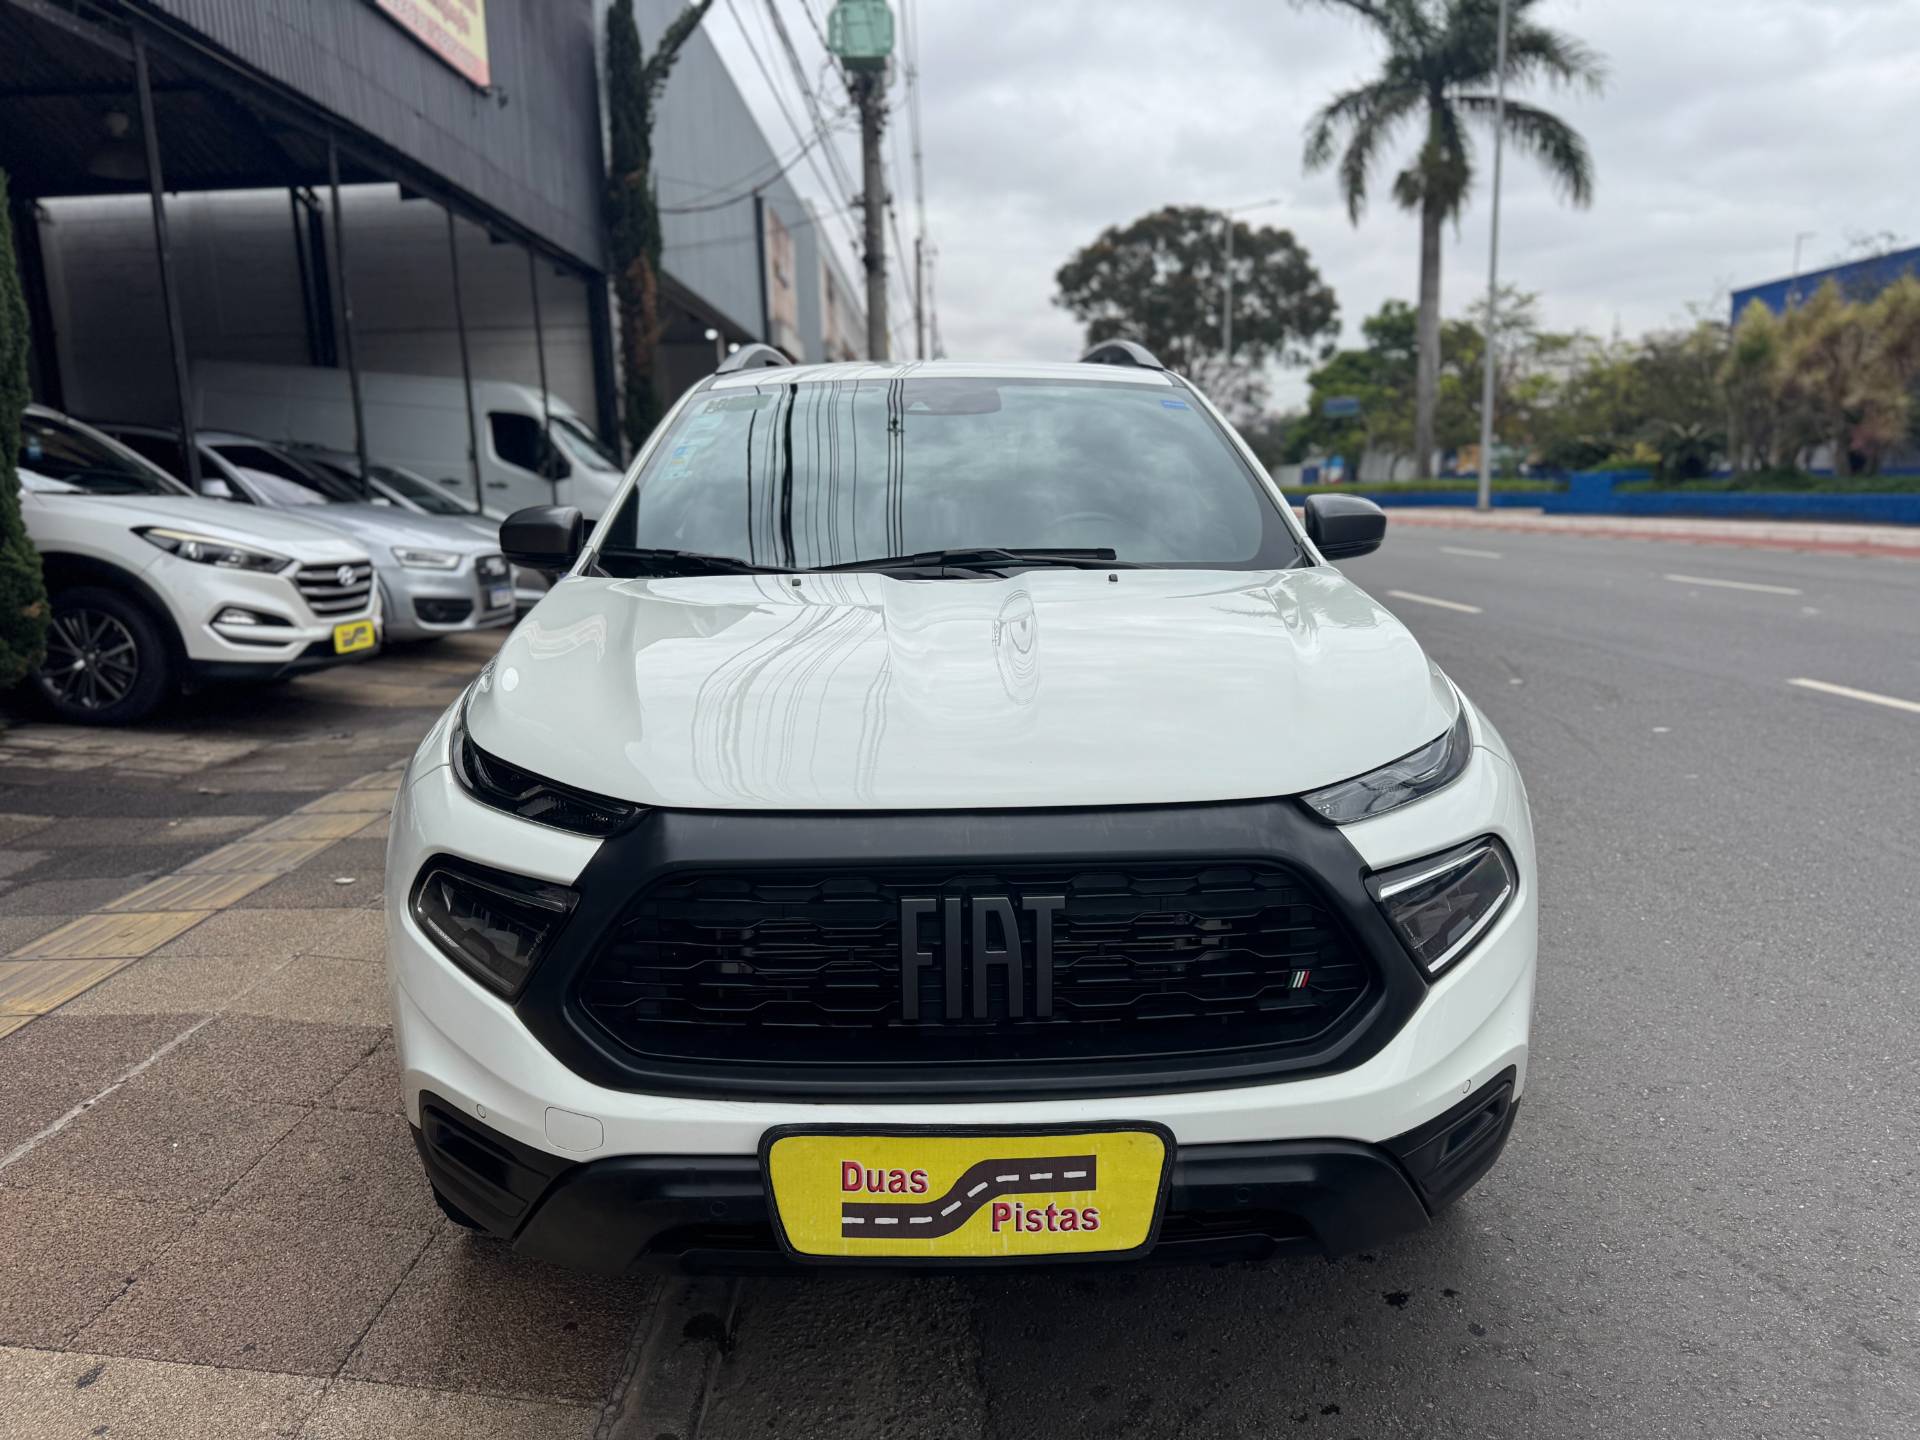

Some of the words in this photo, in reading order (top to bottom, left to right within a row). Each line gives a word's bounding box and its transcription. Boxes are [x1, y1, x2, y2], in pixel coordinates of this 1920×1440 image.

[901, 896, 1066, 1020] FIAT
[841, 1160, 929, 1194] Duas
[991, 1201, 1100, 1232] Pistas
